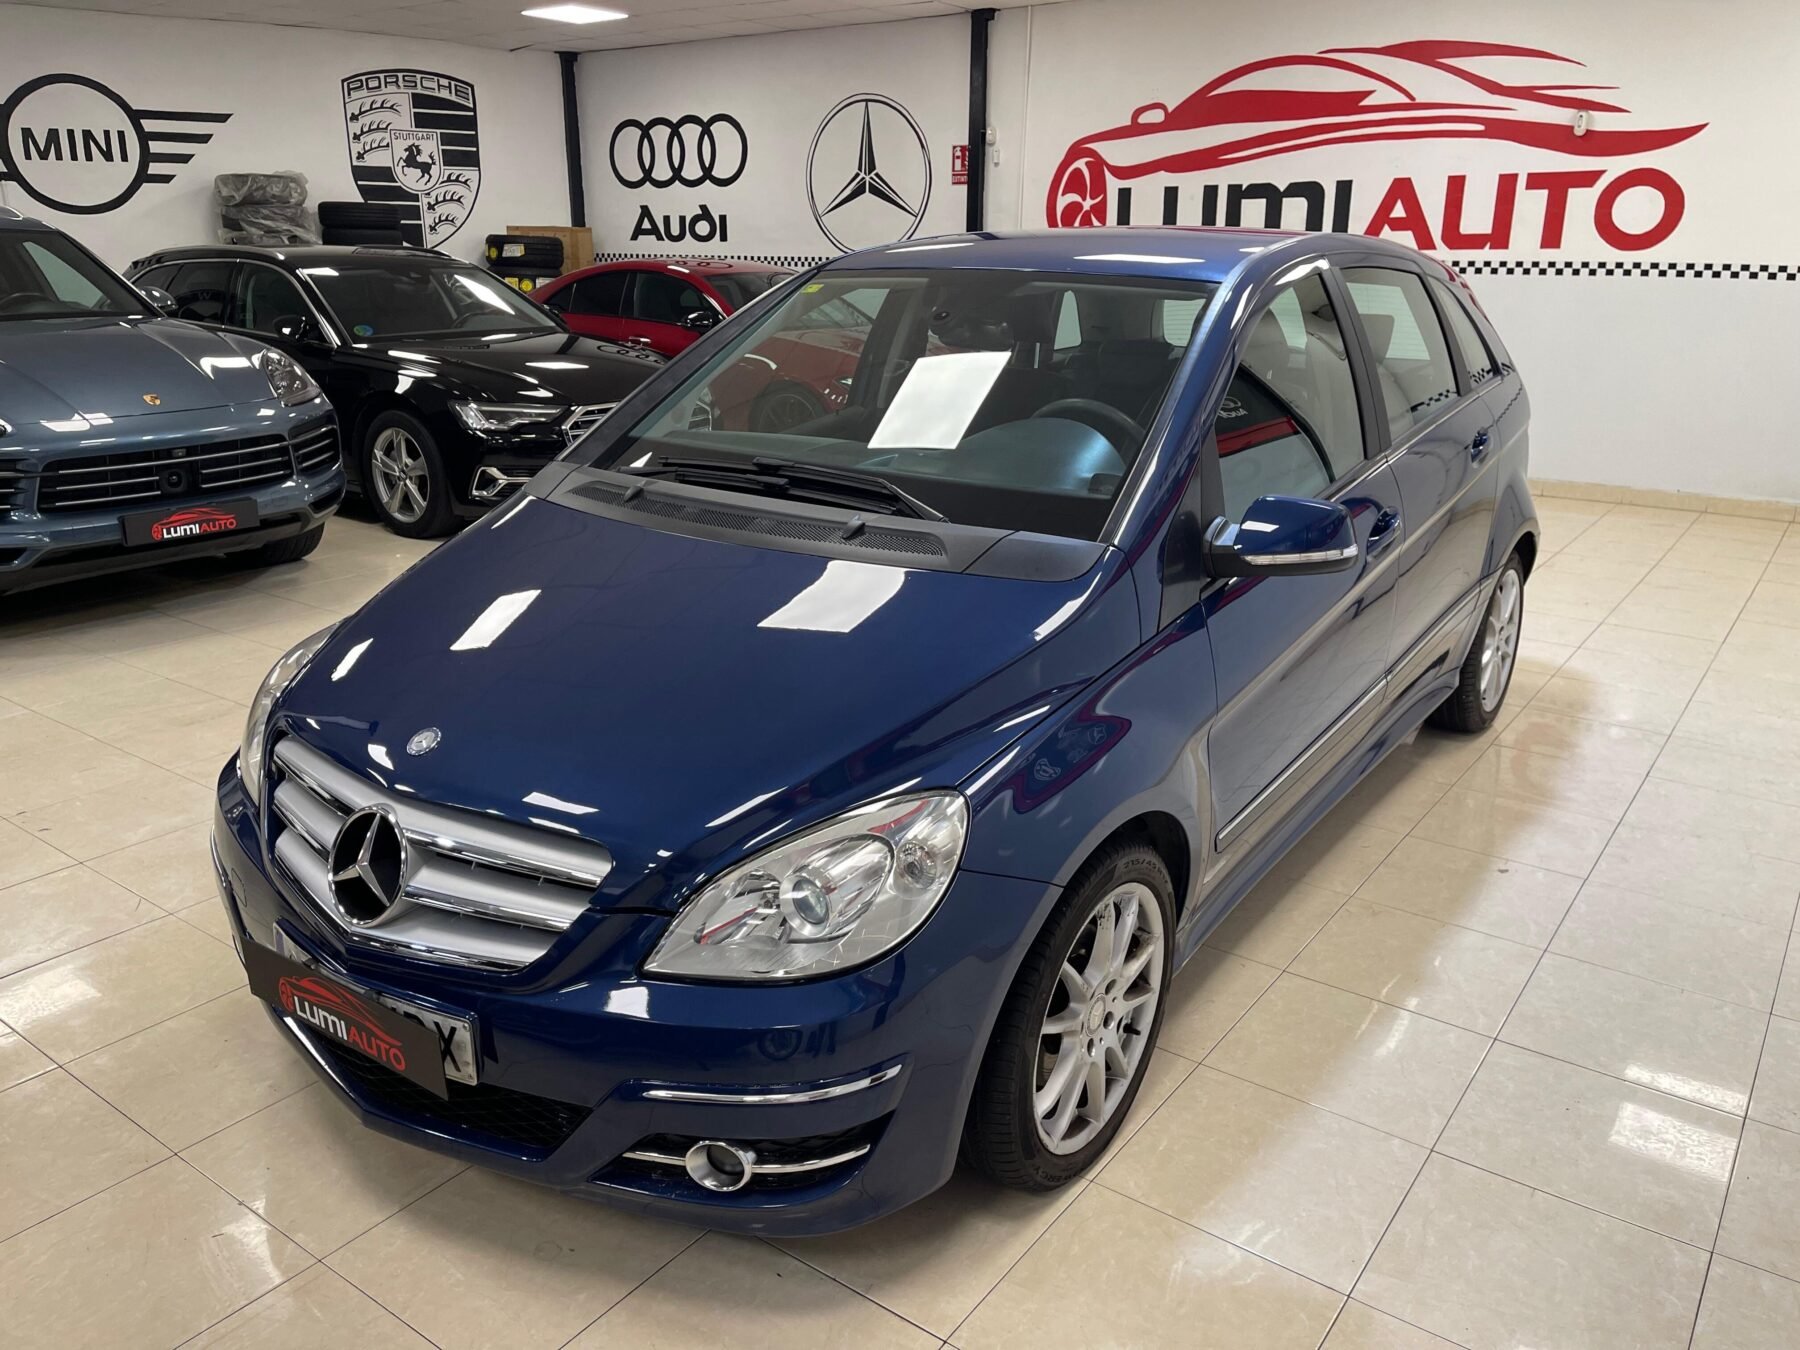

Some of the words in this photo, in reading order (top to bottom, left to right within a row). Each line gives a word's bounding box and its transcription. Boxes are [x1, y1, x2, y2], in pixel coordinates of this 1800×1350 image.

[346, 74, 471, 101] PORSCHE
[22, 127, 129, 163] MINI
[393, 132, 435, 142] STUTTGART
[630, 204, 728, 242] Audi
[162, 518, 237, 539] LUMIAUTO
[293, 996, 407, 1072] LUMIAUTO
